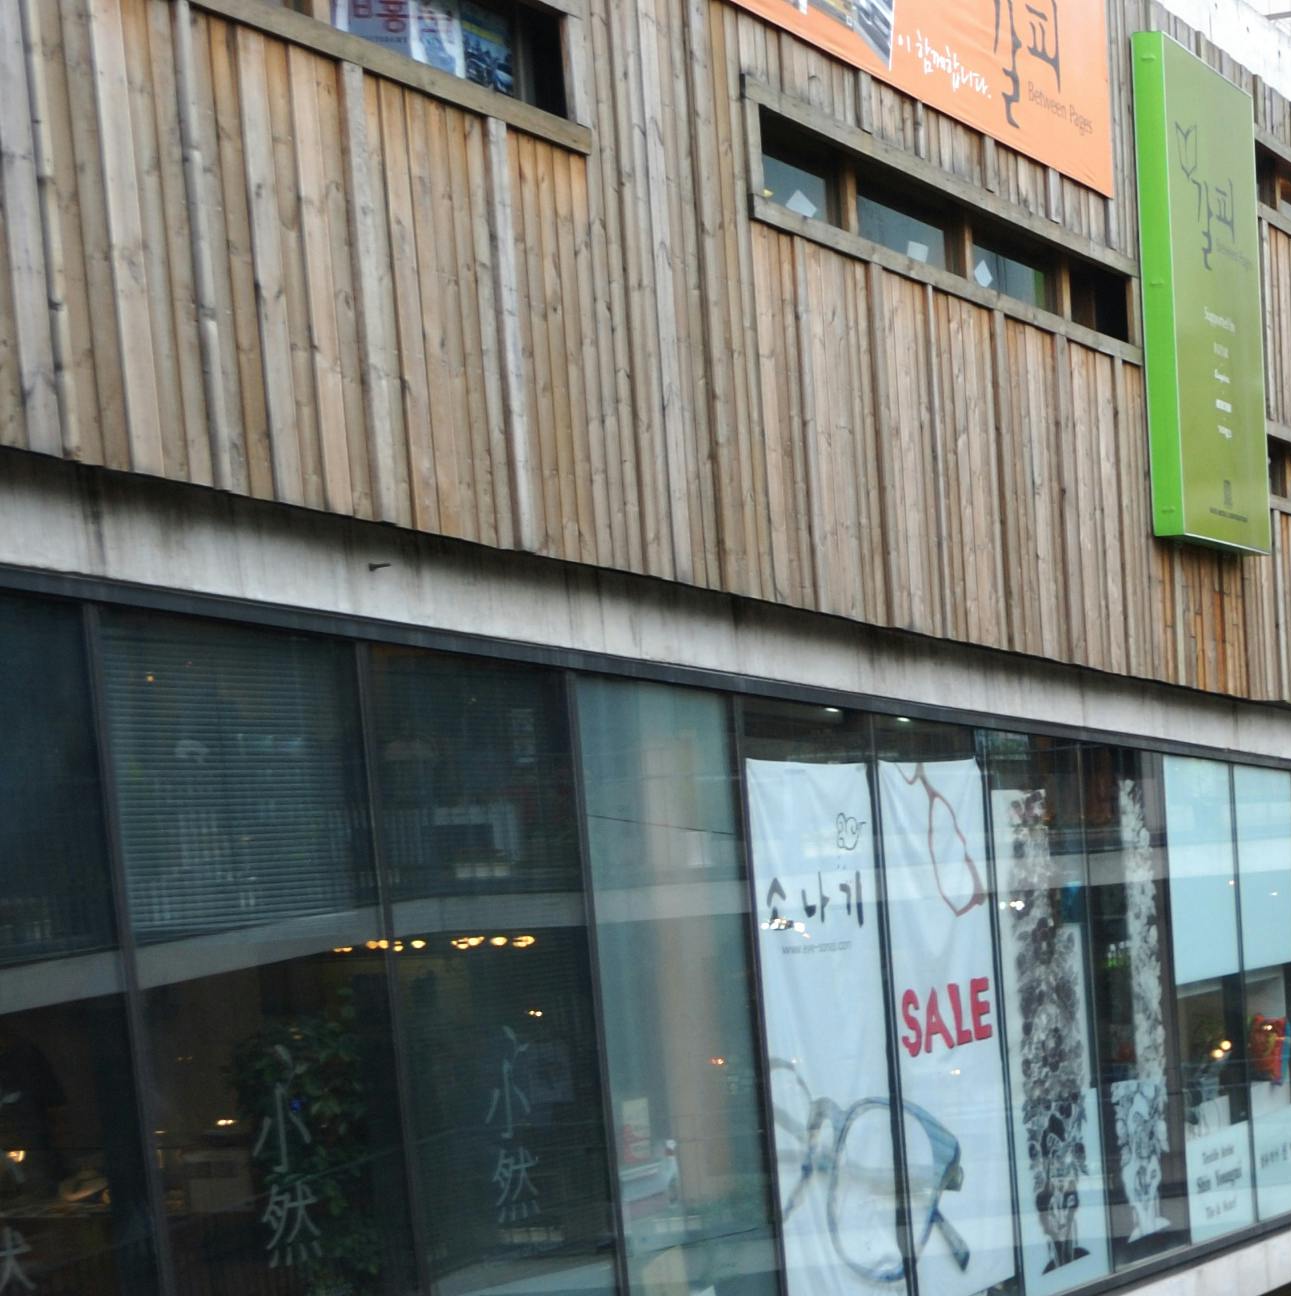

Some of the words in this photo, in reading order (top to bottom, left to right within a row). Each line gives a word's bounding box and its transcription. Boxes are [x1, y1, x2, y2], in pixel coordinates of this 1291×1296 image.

[1027, 80, 1068, 121] Between
[1069, 105, 1095, 136] Pages
[765, 869, 865, 932] 소나기
[901, 976, 993, 1058] SALE
